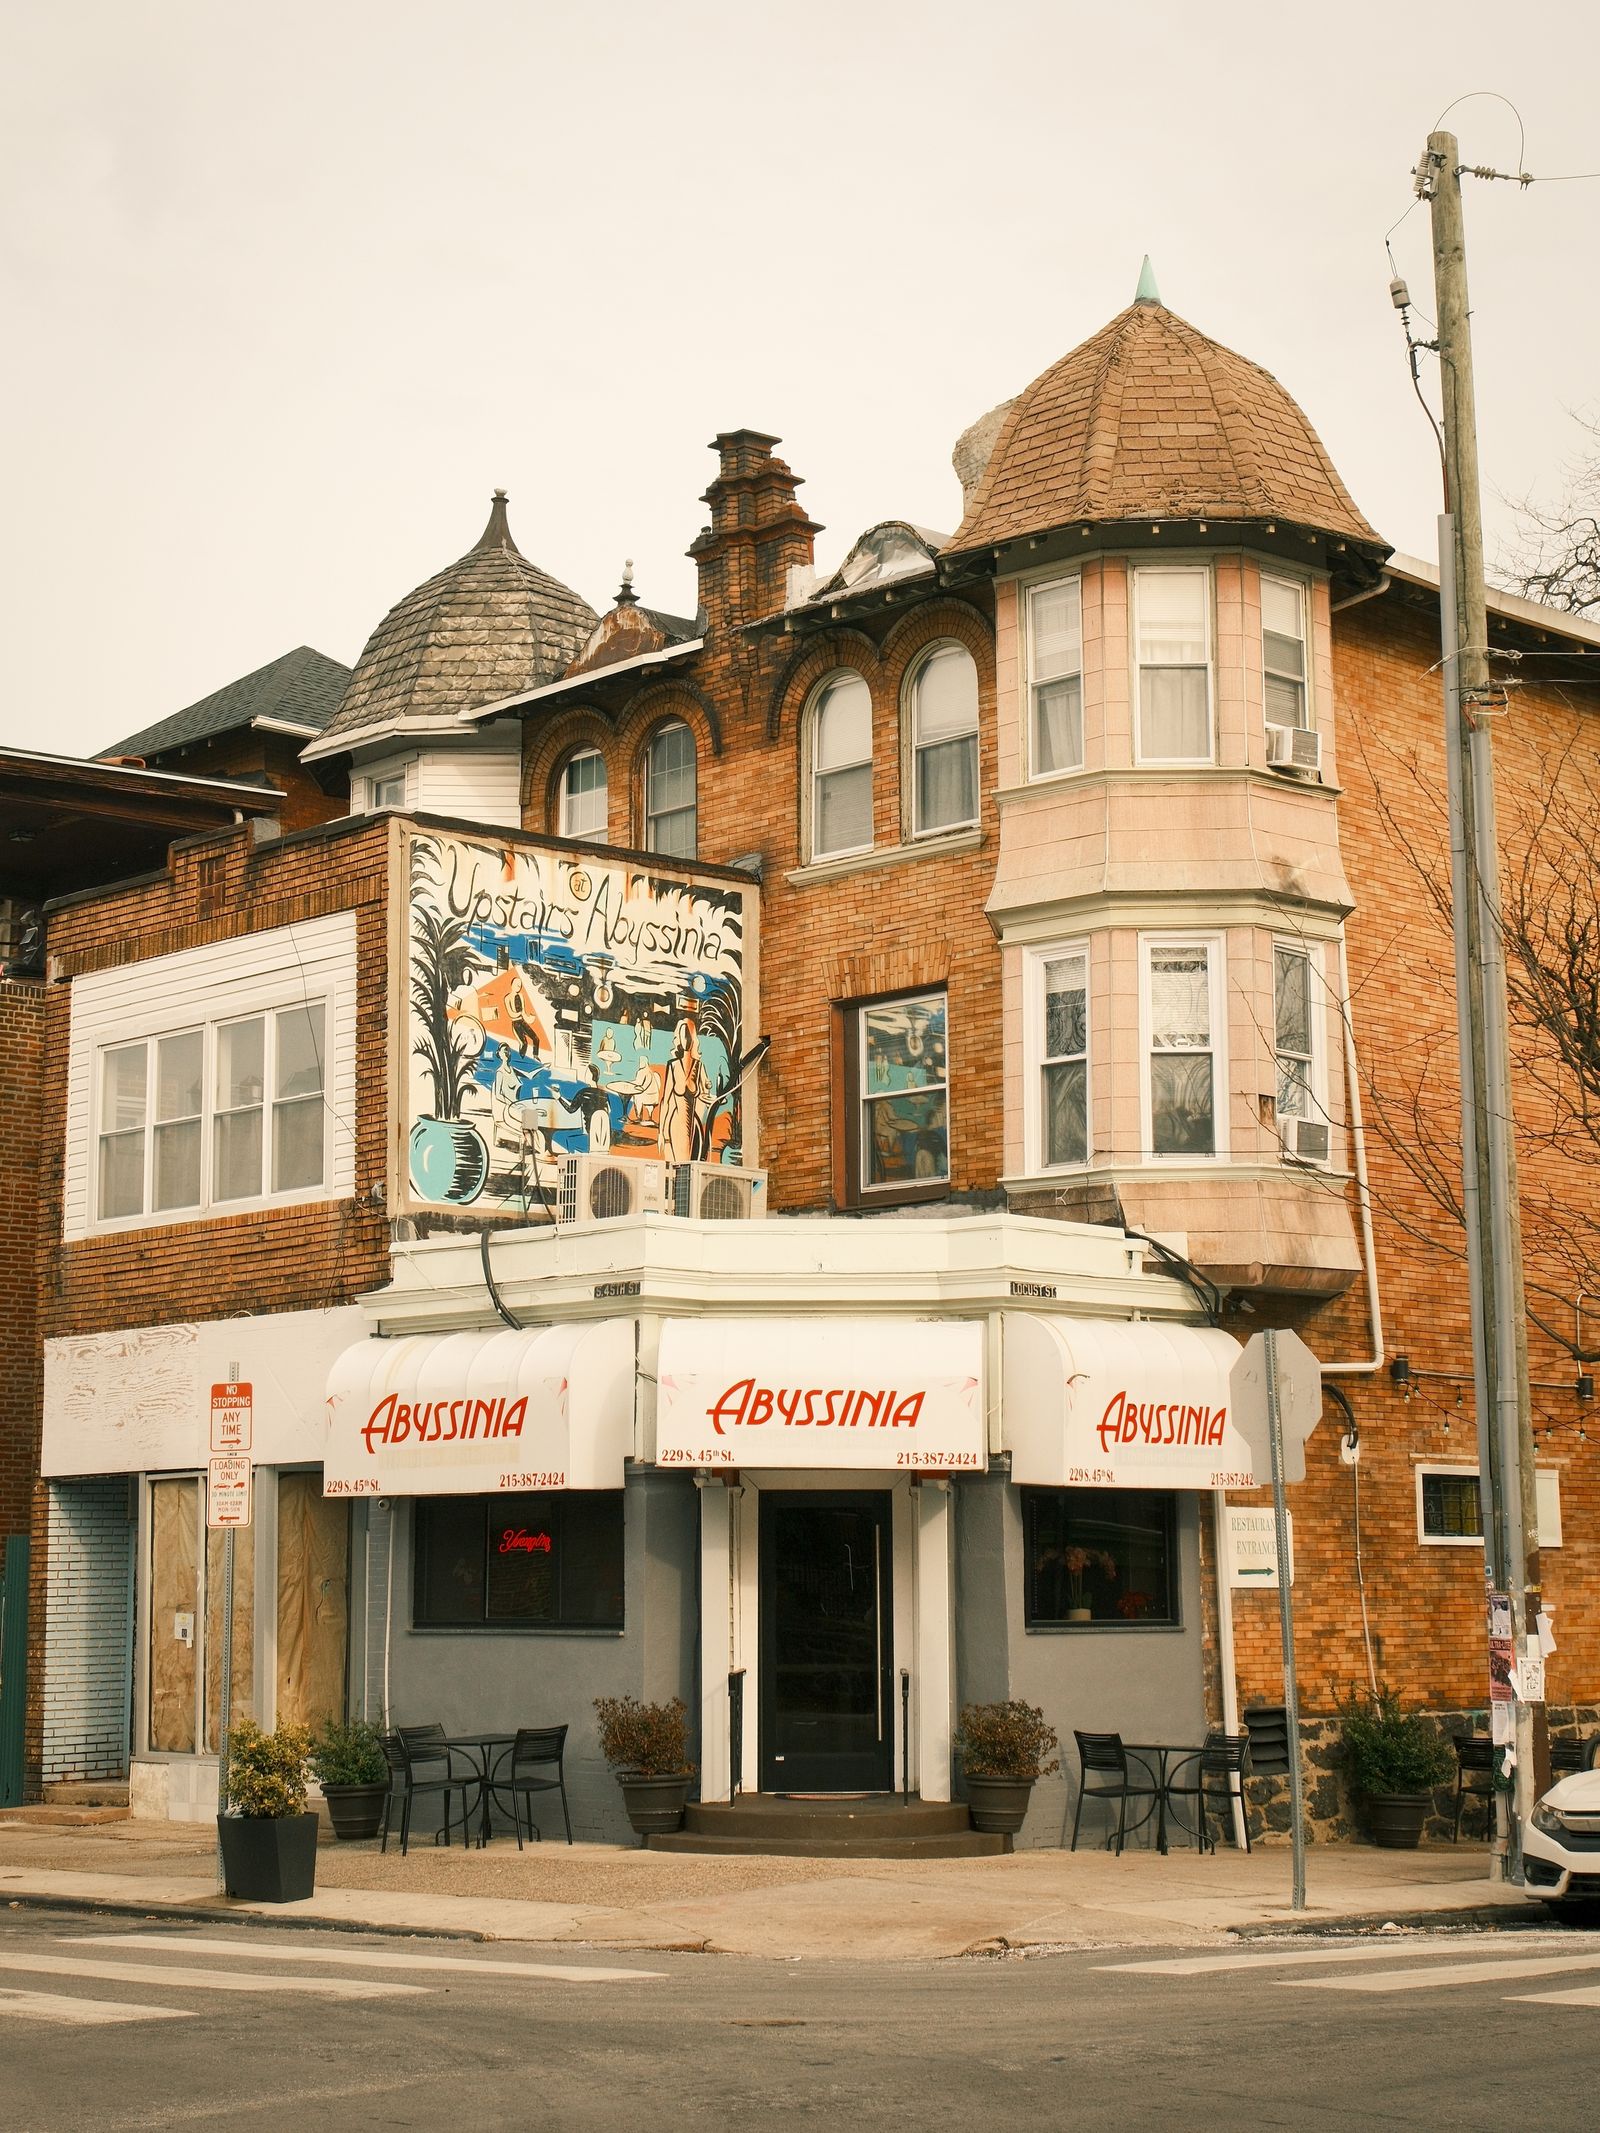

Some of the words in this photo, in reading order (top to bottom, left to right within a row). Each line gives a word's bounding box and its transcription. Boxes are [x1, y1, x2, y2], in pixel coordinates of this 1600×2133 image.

[447, 844, 579, 939] Upstairs
[585, 874, 722, 965] Abyssinia
[1012, 1282, 1042, 1297] LOCUST
[226, 1384, 238, 1395] NO
[212, 1396, 251, 1408] STOPPING
[705, 1378, 926, 1434] ABYSSINIA
[222, 1411, 241, 1423] ANY
[360, 1392, 529, 1454] ABYSSINIA
[1096, 1391, 1227, 1453] ABYSSINIA
[221, 1424, 242, 1436] TIME
[662, 1449, 684, 1462] 229
[686, 1449, 696, 1462] S.
[698, 1449, 720, 1462] 45th
[721, 1449, 735, 1462] St.
[896, 1452, 977, 1465] 215-387-2424
[214, 1460, 246, 1470] LOADING
[220, 1471, 239, 1481] ONLY
[499, 1472, 565, 1488] 215-387-2424
[1069, 1468, 1084, 1482] 229
[1084, 1469, 1091, 1482] S.
[1106, 1469, 1116, 1482] St.
[1211, 1472, 1254, 1486] 215-387-242
[326, 1480, 343, 1493] 229
[344, 1480, 352, 1492] S.
[370, 1478, 381, 1491] St.
[1231, 1517, 1276, 1531] RESTAURAN
